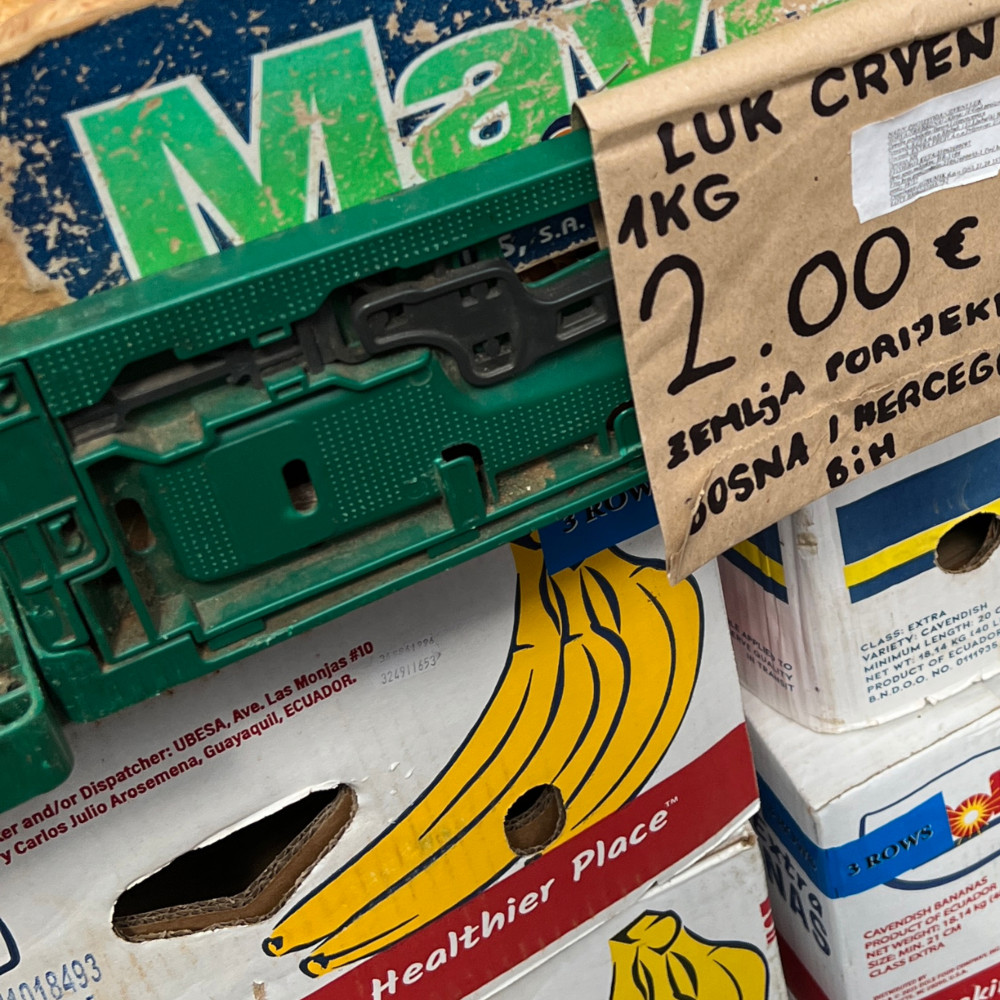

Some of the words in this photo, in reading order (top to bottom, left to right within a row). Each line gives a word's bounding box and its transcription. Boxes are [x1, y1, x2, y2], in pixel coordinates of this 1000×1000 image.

[657, 89, 782, 174] LUK
[539, 217, 585, 244] S.A.
[617, 173, 739, 249] 1KG
[640, 226, 910, 395] 2.00
[933, 216, 981, 269] €
[860, 628, 904, 652] CLASS:
[908, 610, 947, 632] EXTRA
[862, 634, 917, 662] VARIETY:
[921, 602, 988, 636] CAVENDISH
[864, 644, 921, 673] MINIMUM
[924, 621, 974, 647] LENGTH:
[978, 612, 991, 623] 20
[866, 668, 889, 683] NET
[893, 657, 915, 671] WT:
[919, 644, 947, 661] 18.14
[951, 635, 967, 647] KG
[970, 623, 989, 637] (40
[778, 659, 793, 671] TO
[867, 664, 925, 694] PRODUCT
[928, 655, 945, 667] OF
[868, 675, 928, 704] B.N.D.O.O.
[931, 664, 953, 678] NO.
[956, 641, 999, 666] 0111935
[21, 793, 78, 829] and/or
[79, 747, 173, 800] Dispatcher:
[173, 717, 231, 752] UBESA,
[232, 702, 265, 723] Ave.
[264, 685, 293, 706] Las
[294, 656, 348, 691] Monjas
[349, 641, 374, 662] #10
[0, 849, 12, 865] y
[13, 822, 69, 855] Carlos
[69, 802, 108, 828] Julio
[109, 754, 202, 808] Arosemena,
[203, 712, 283, 759] Guayaquil,
[283, 673, 357, 717] ECUADOR.
[847, 862, 860, 877] 3
[866, 823, 935, 871] ROWS
[863, 906, 932, 939] CAVENDISH
[934, 875, 988, 911] BANANAS
[865, 922, 922, 950] PRODUCT
[925, 912, 941, 925] OF
[943, 883, 997, 916] ECUADOR
[866, 946, 888, 960] NET
[891, 925, 940, 951] WEIGHT:
[943, 909, 971, 928] 18.14
[974, 901, 987, 912] kg
[371, 878, 555, 1000] Healthier
[867, 954, 896, 970] SIZE:
[899, 943, 924, 957] MIN.
[927, 934, 940, 945] 21
[943, 923, 962, 937] CM
[869, 960, 905, 978] CLASS
[908, 942, 944, 963] EXTRA
